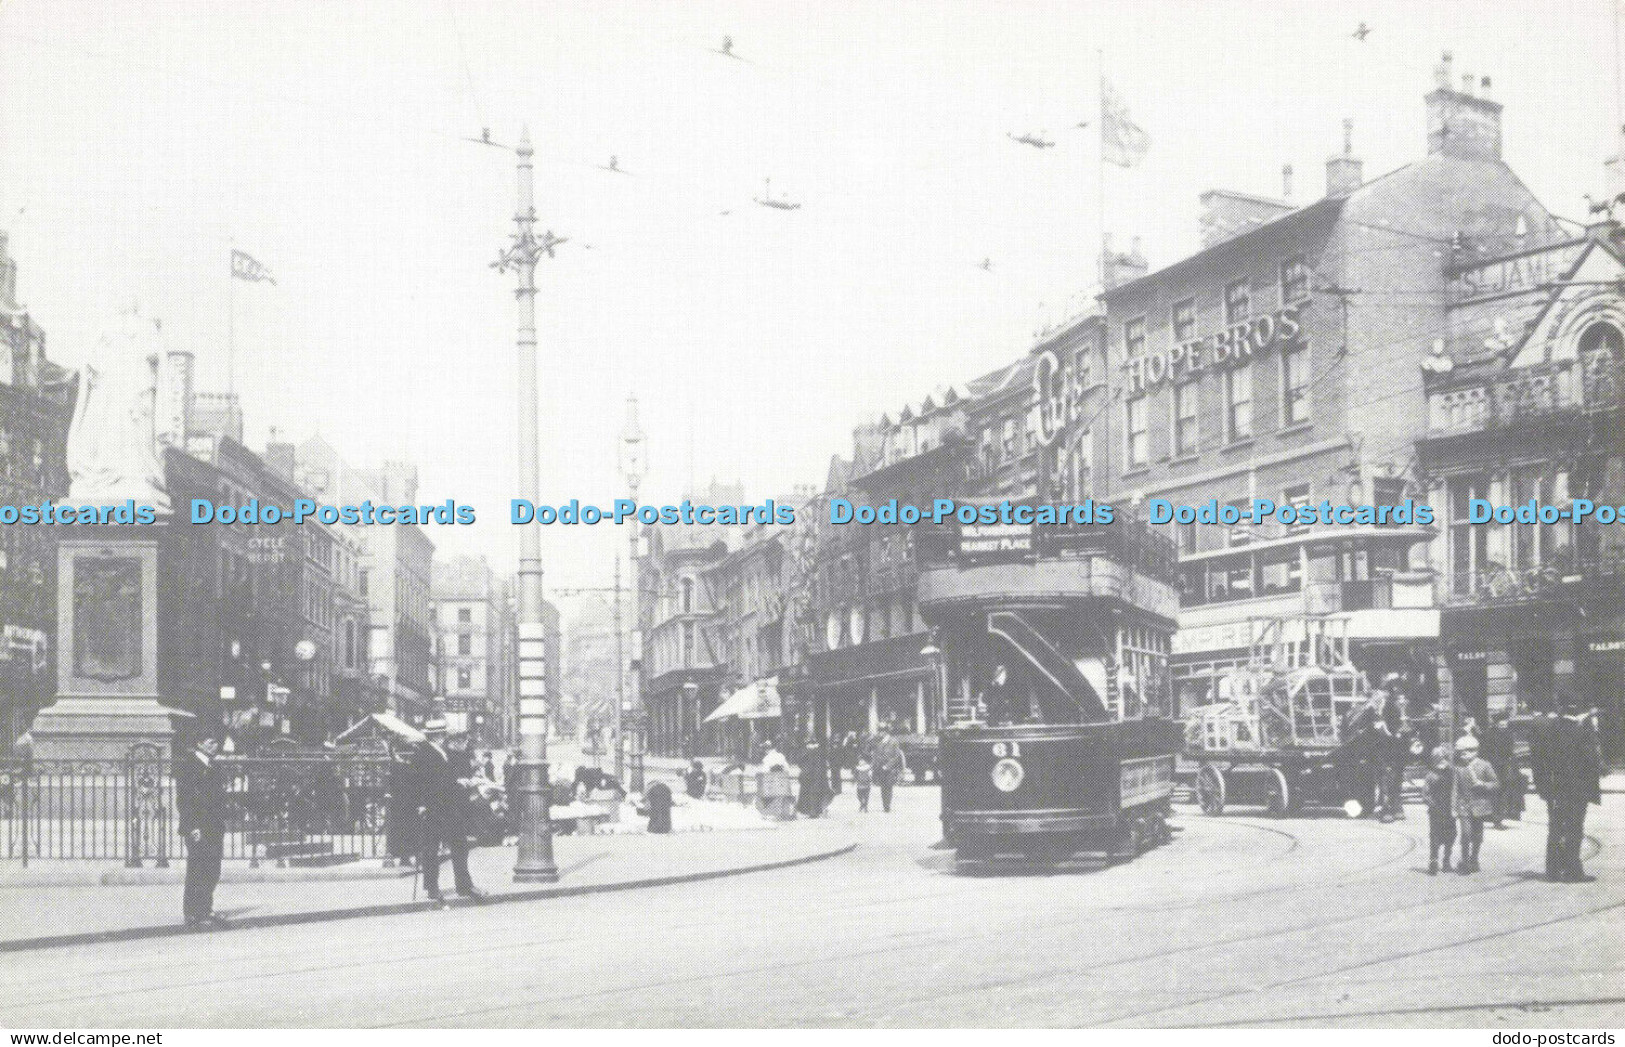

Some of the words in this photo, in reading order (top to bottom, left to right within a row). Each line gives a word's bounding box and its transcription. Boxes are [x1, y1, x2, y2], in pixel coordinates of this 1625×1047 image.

[1128, 337, 1204, 392] HOPE
[1213, 312, 1300, 363] BROS
[1000, 538, 1031, 550] PLACE
